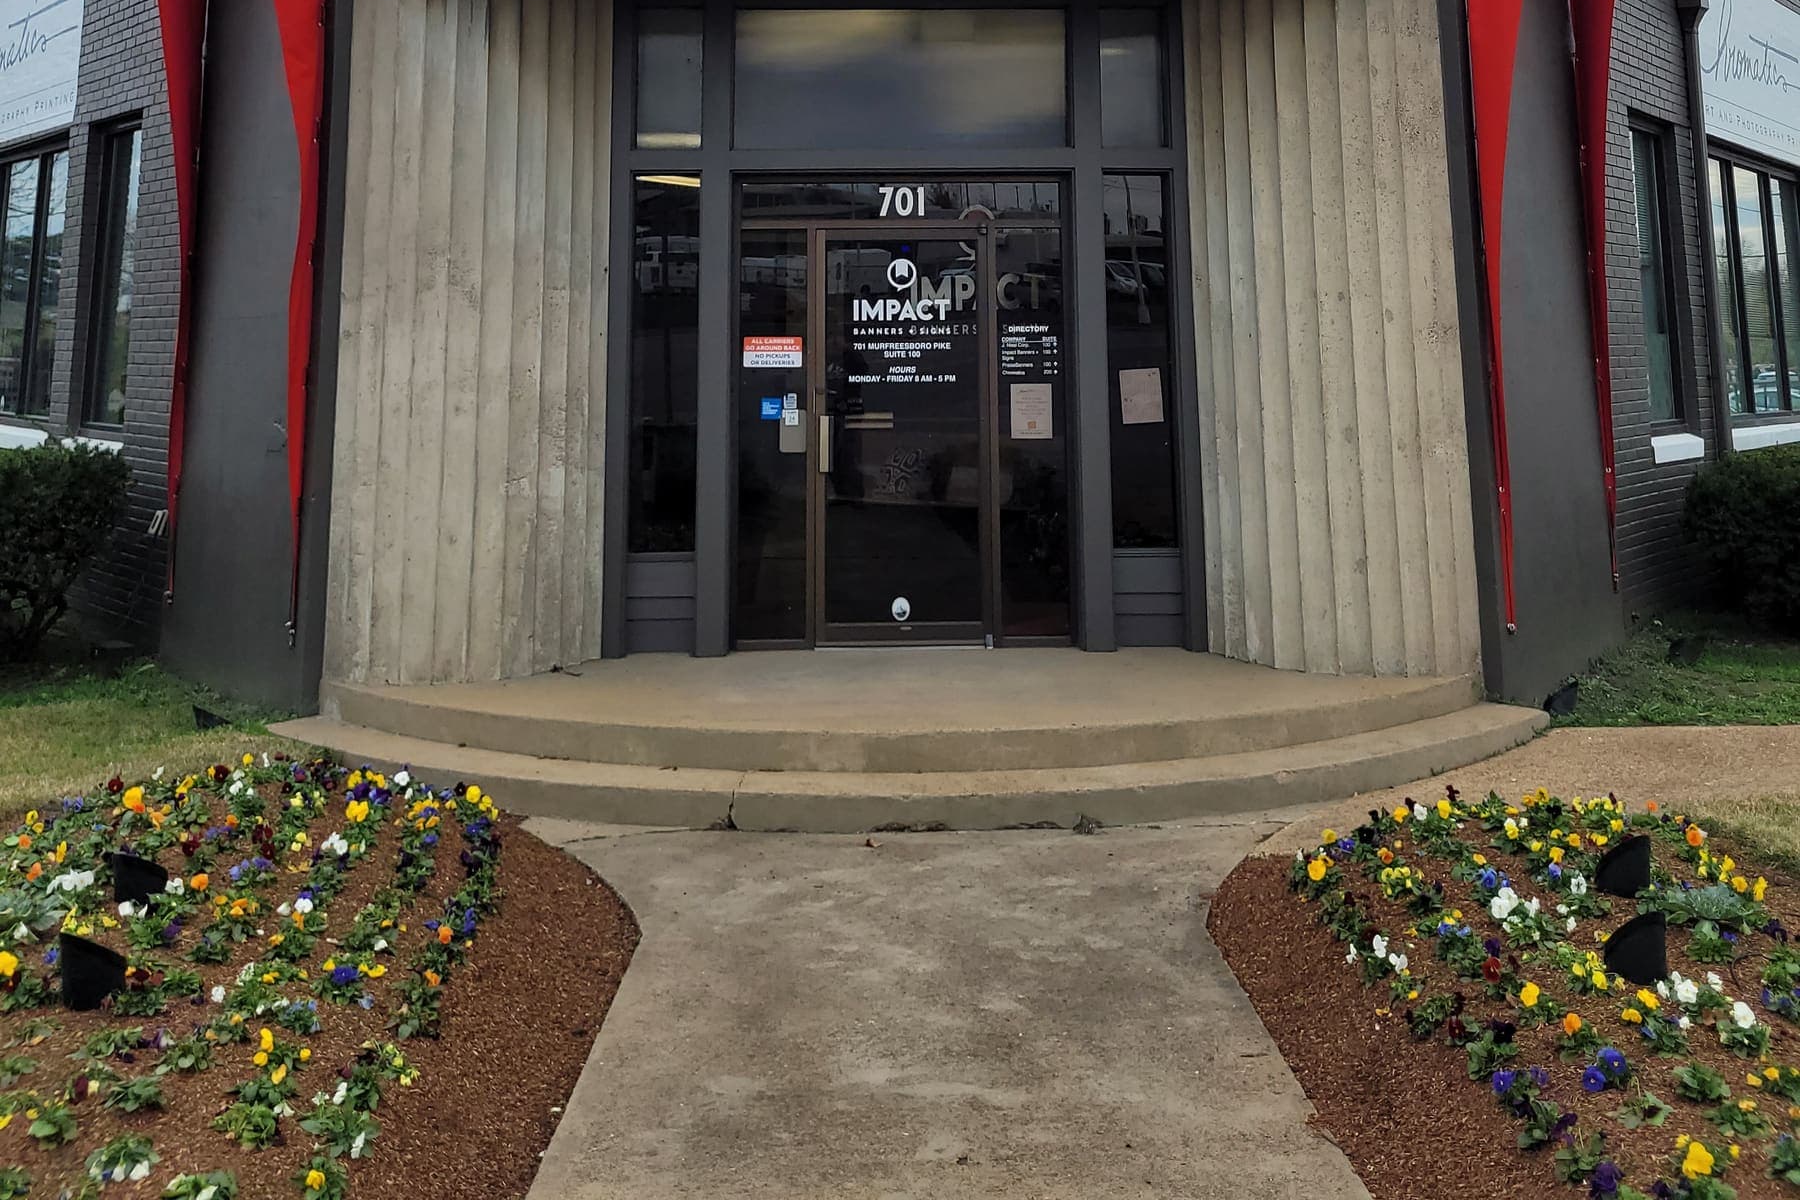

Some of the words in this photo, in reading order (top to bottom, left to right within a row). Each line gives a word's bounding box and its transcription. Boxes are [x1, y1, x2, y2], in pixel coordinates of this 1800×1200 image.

[878, 186, 925, 217] 701
[910, 274, 1041, 311] IMPCT
[853, 299, 951, 321] IMPACT
[853, 327, 903, 335] BANNERS
[920, 327, 951, 335] SIGNS
[1008, 325, 1049, 333] DIRECTORY
[868, 342, 932, 350] MURFREESBORO
[933, 342, 951, 350] PIKE
[889, 366, 917, 374] HOURS
[848, 375, 881, 383] MONDAY
[887, 375, 913, 383] FRIDAY
[921, 375, 933, 383] AM
